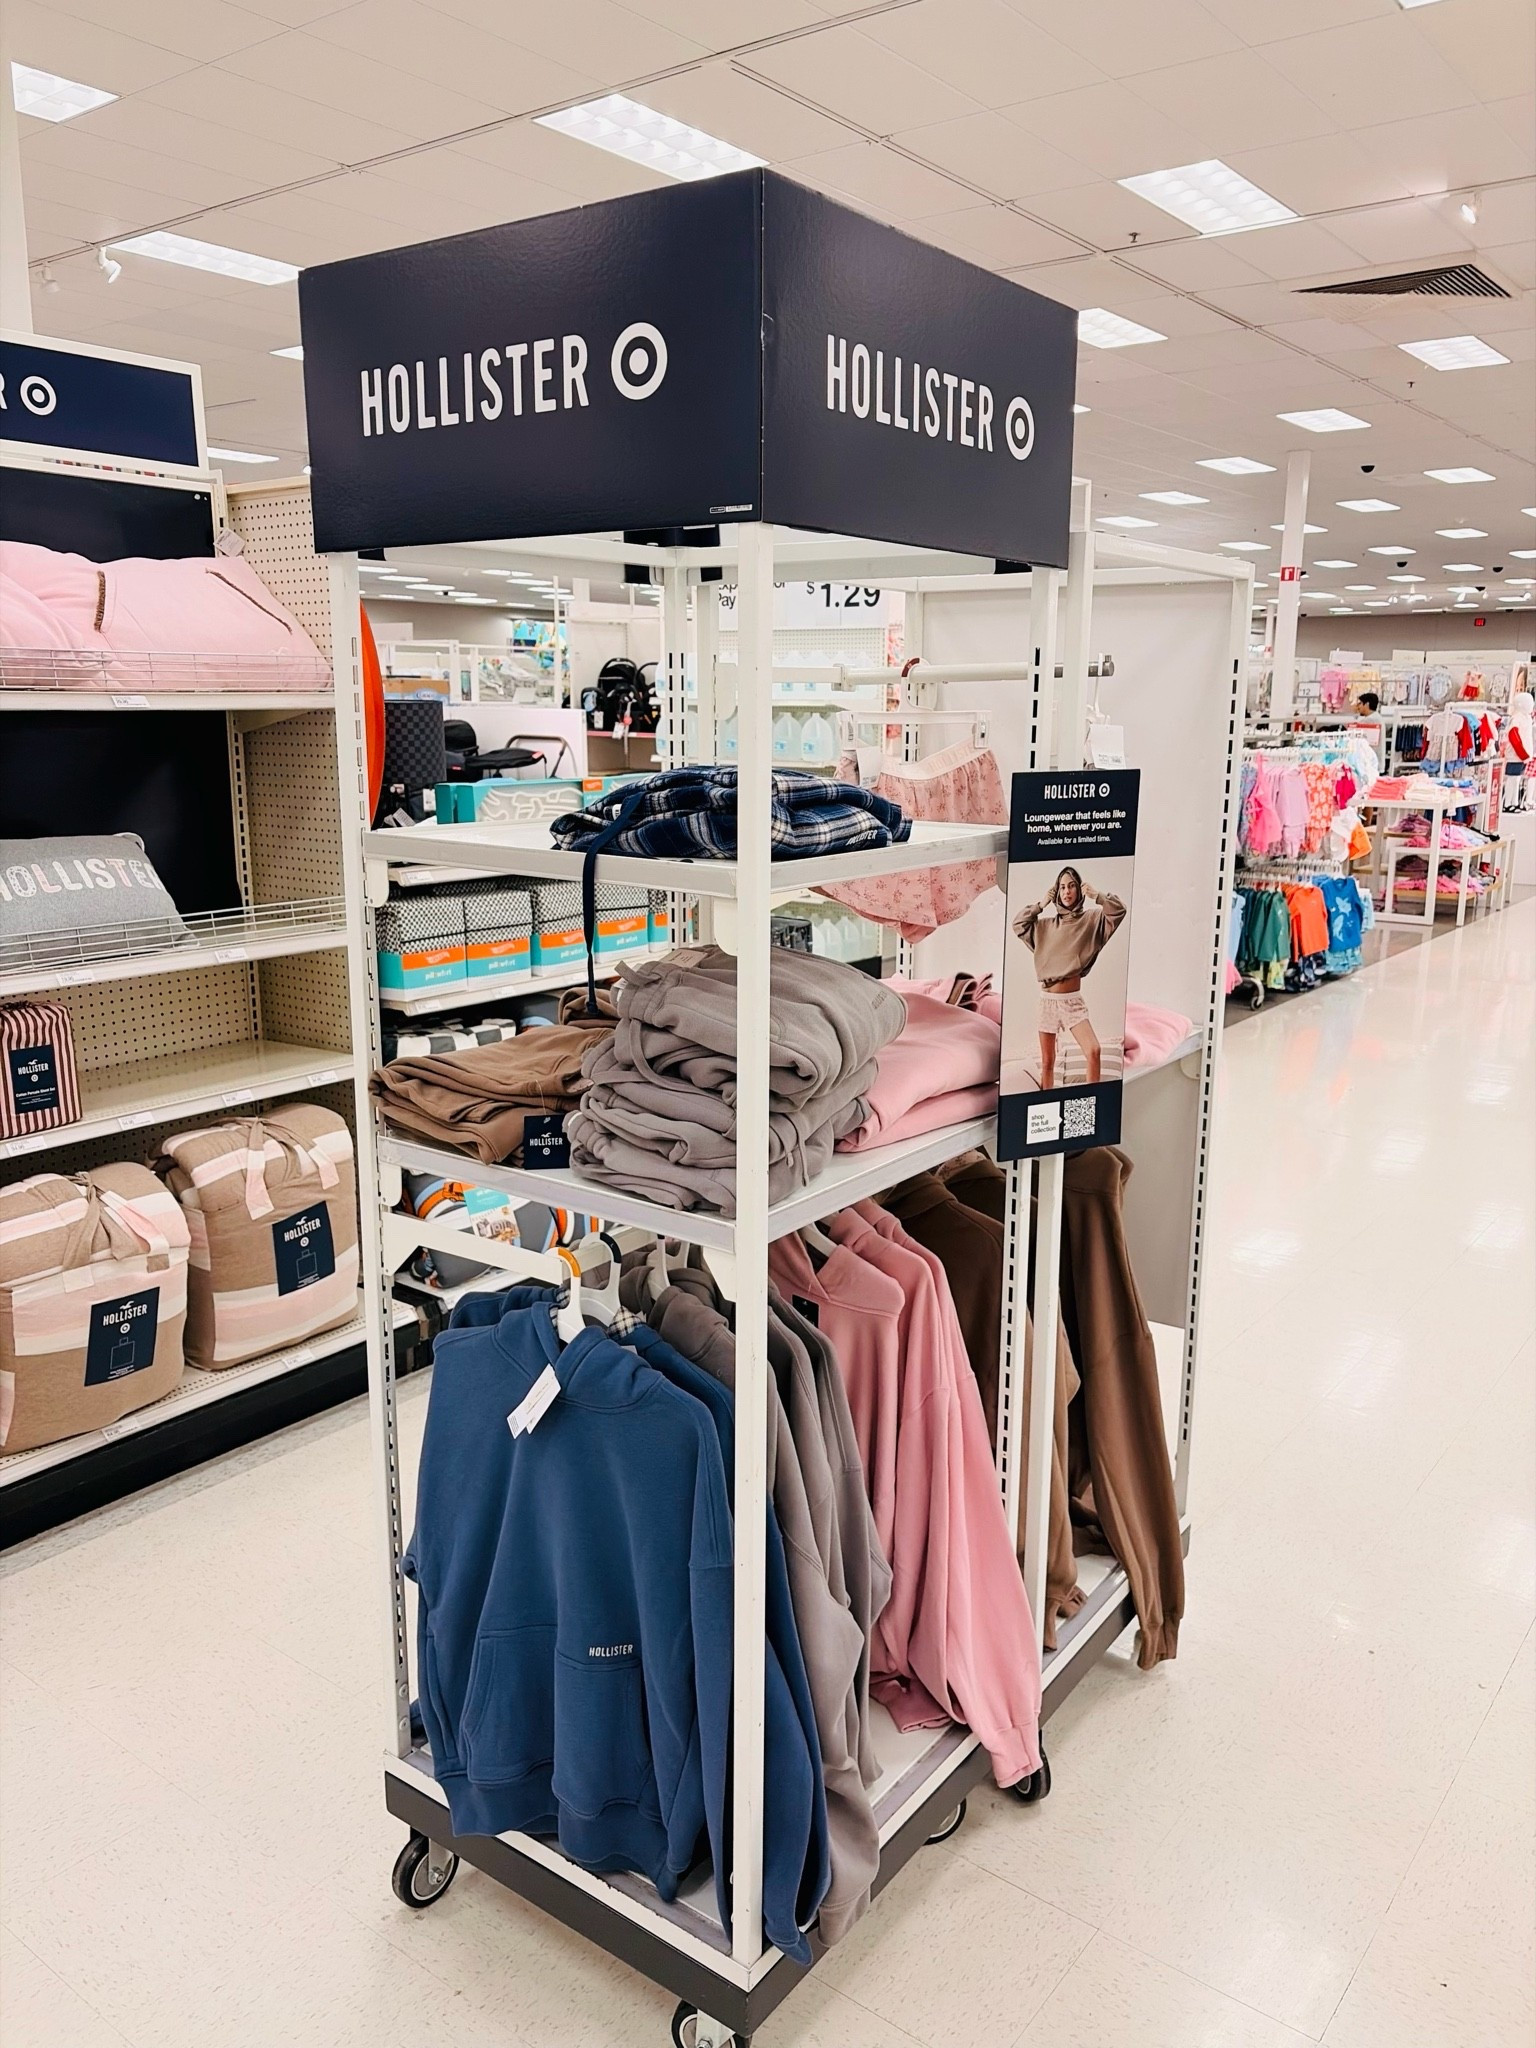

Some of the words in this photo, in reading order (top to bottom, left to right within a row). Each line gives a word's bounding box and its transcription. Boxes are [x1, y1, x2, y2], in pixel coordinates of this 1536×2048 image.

[361, 334, 590, 437] HOLLISTER
[827, 333, 994, 452] HOLLISTER
[1044, 783, 1096, 800] HOLLISTER
[1024, 813, 1074, 823] Loungewear
[1075, 811, 1091, 820] that
[1092, 810, 1111, 819] feels
[1112, 809, 1126, 818] like
[1027, 824, 1052, 833] home,
[1054, 822, 1090, 832] wherever
[1091, 823, 1105, 832] you
[1037, 837, 1063, 846] Available
[1078, 835, 1096, 843] limited
[18, 1063, 49, 1075] HOLLISTER
[1031, 1126, 1056, 1134] collection
[530, 1137, 563, 1146] HOLLISTER
[284, 1218, 321, 1242] HOLLISTER
[103, 1304, 147, 1326] HOLLISTER
[589, 1644, 633, 1657] HOLLISTER
